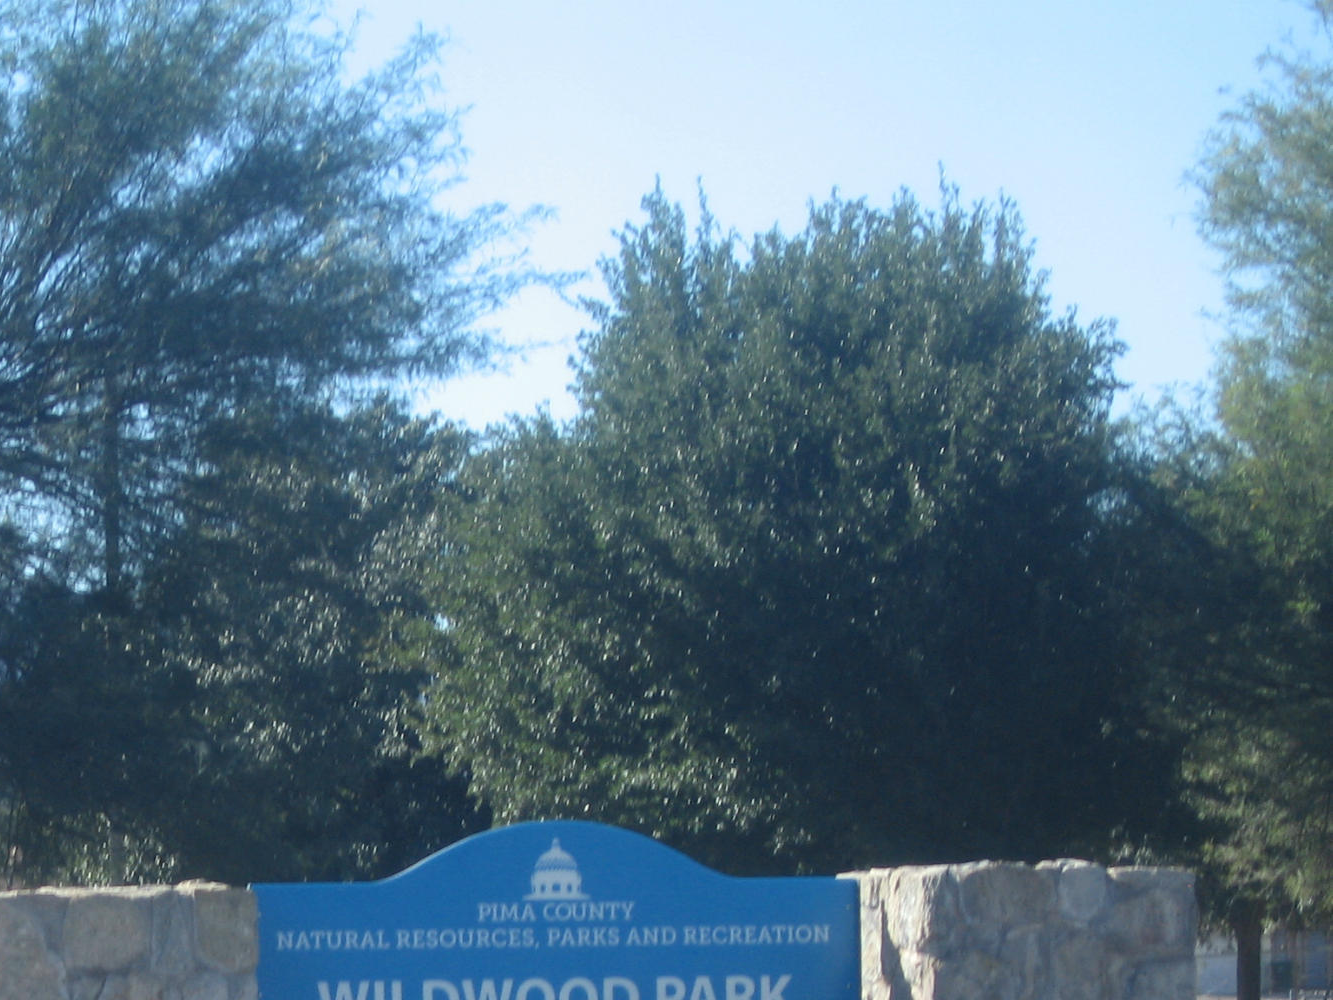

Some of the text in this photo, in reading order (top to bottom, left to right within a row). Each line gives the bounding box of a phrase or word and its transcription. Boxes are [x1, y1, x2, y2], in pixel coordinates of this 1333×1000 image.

[478, 901, 635, 923] PIMA COUNTY
[277, 924, 831, 951] NATURAL RESOURCES, PARKS AND RECREATION
